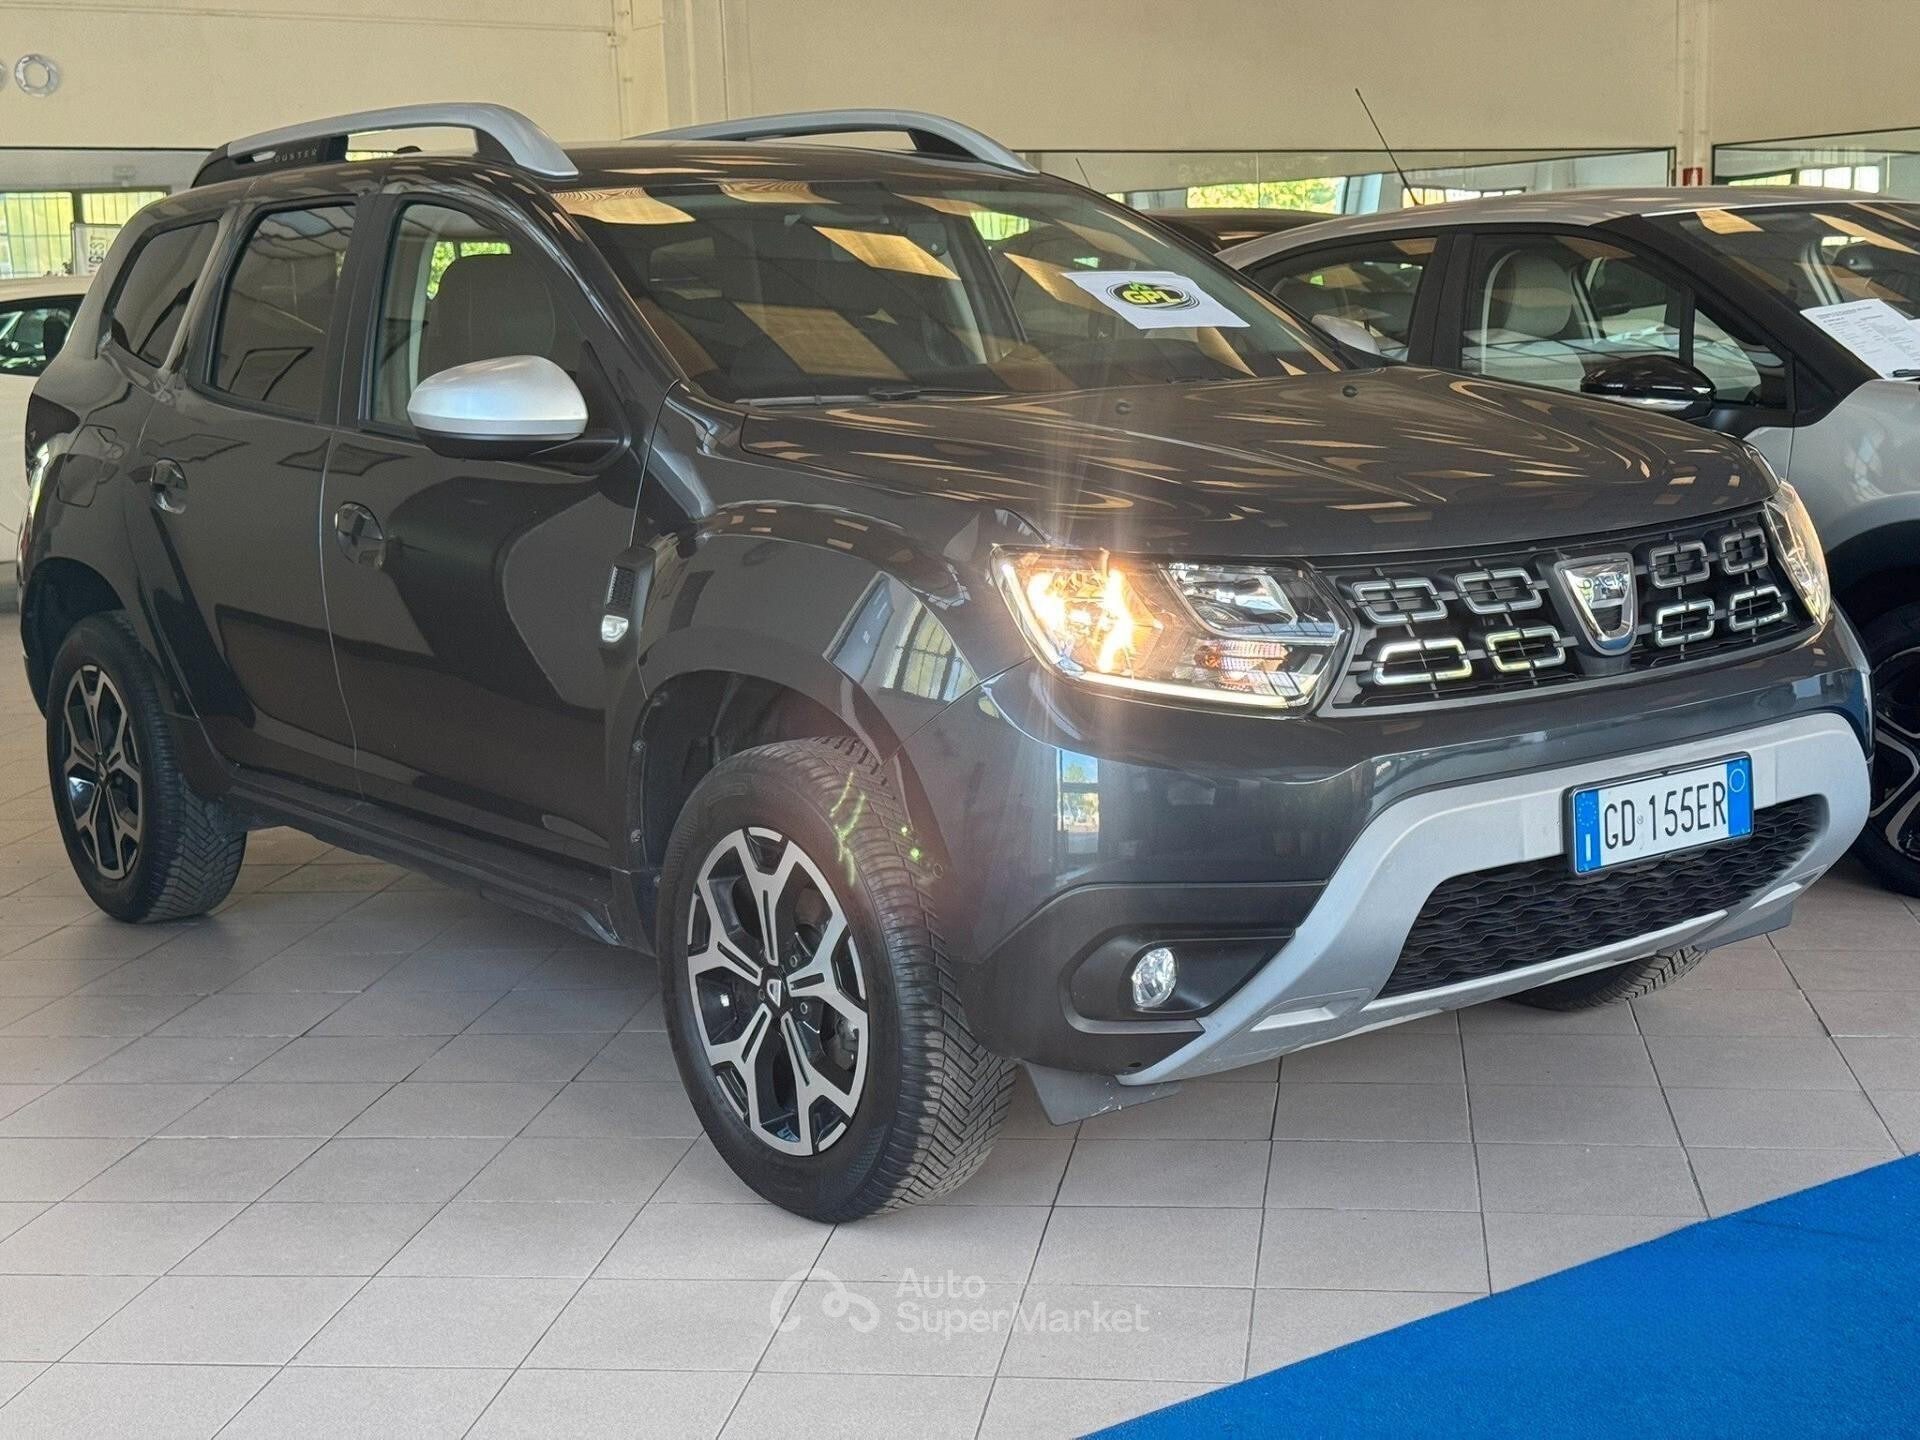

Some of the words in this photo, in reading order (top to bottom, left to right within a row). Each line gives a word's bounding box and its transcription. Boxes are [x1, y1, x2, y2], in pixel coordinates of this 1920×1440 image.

[1121, 289, 1182, 304] GPL
[1604, 799, 1636, 850] GD
[1648, 781, 1727, 841] 155ER
